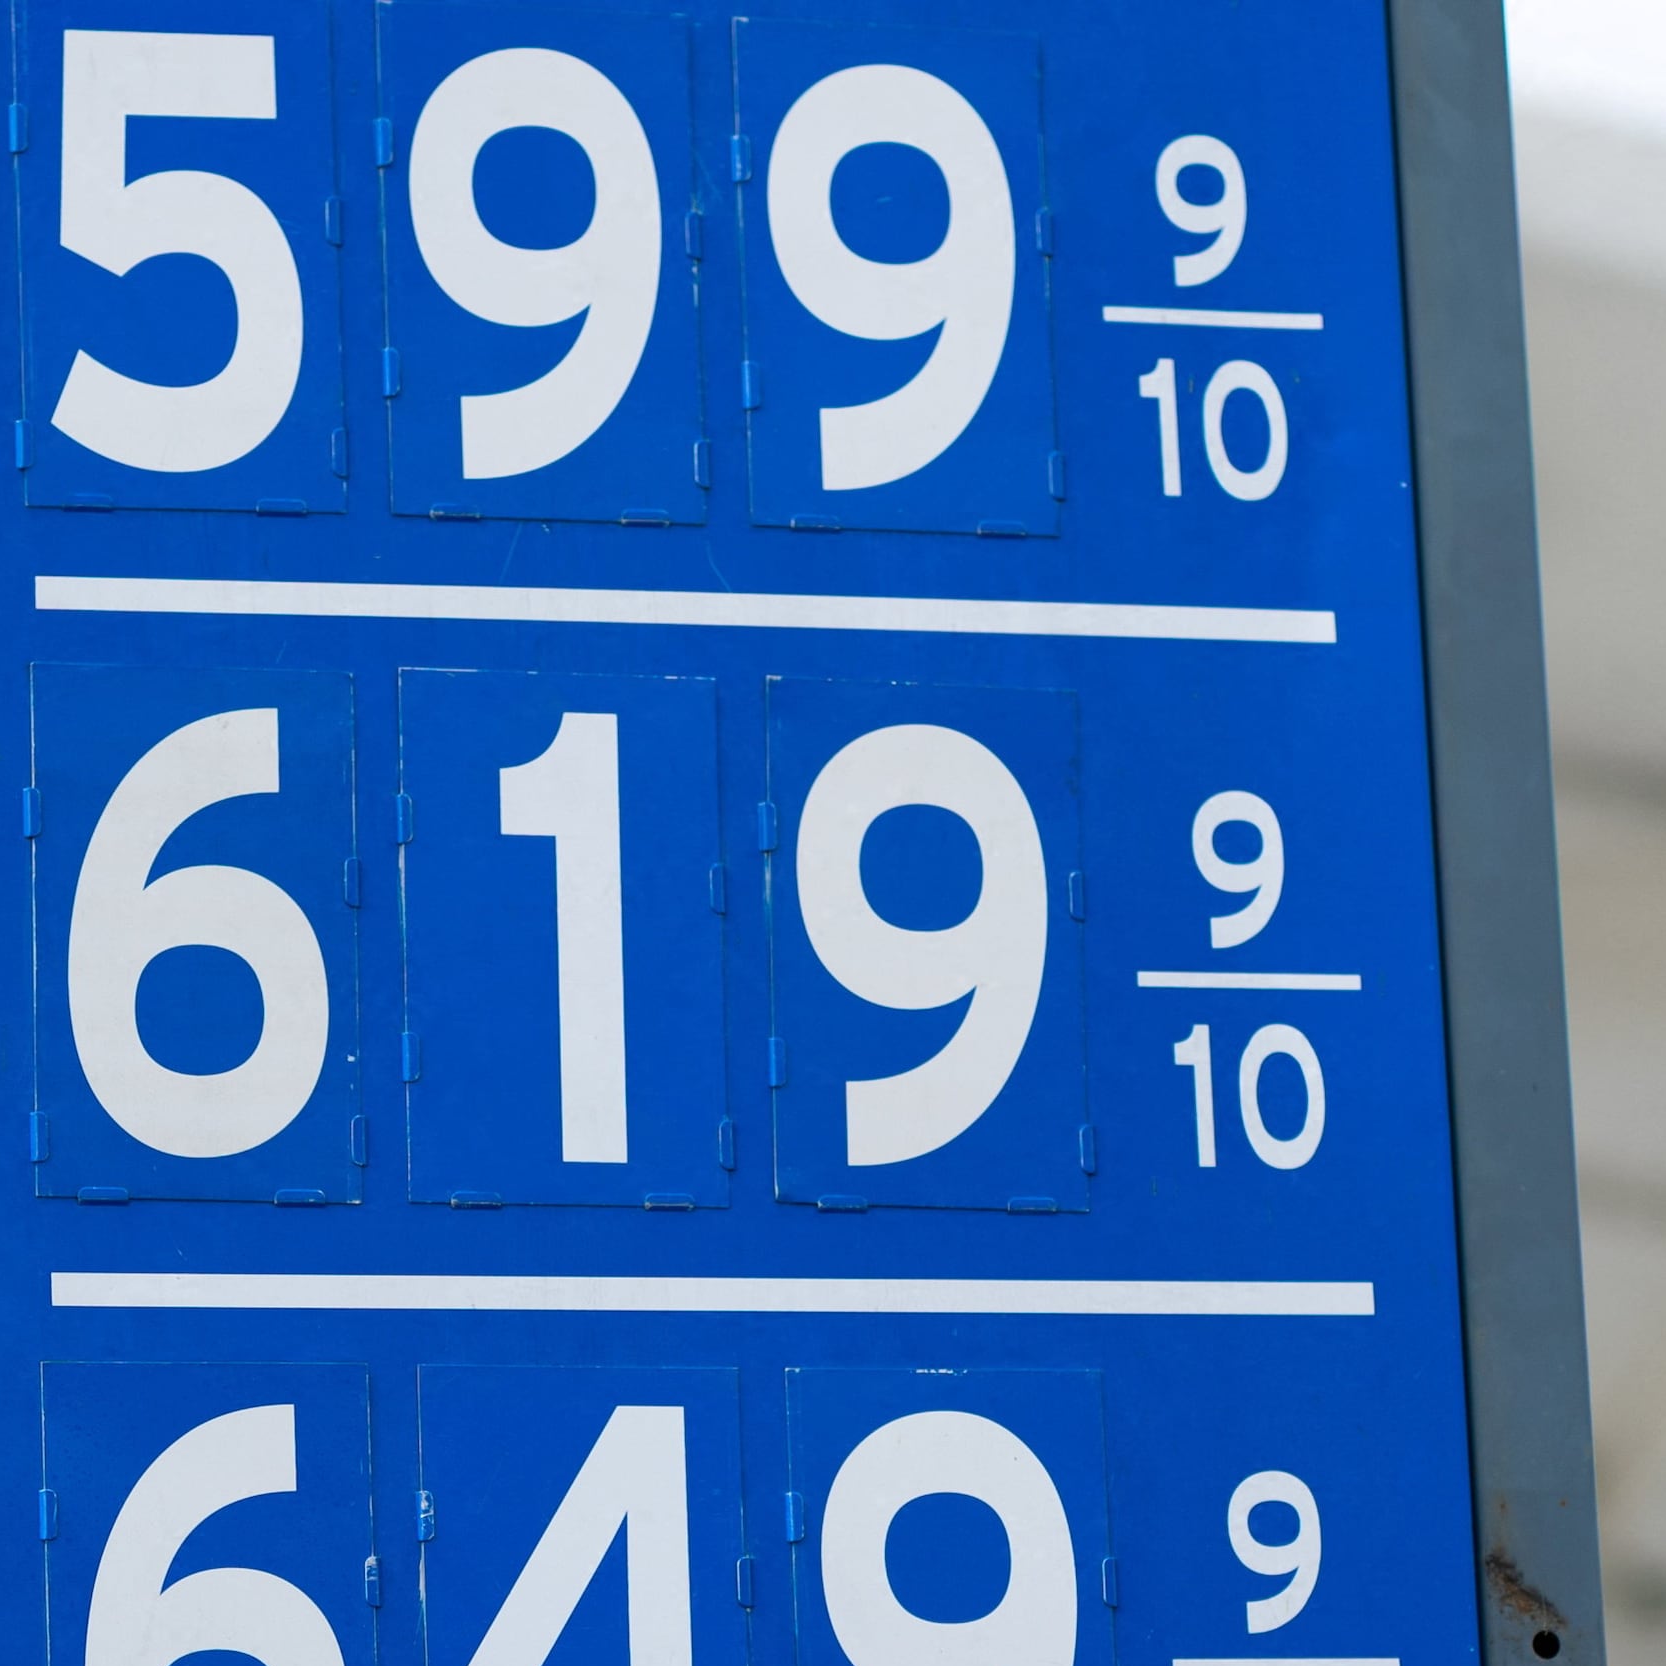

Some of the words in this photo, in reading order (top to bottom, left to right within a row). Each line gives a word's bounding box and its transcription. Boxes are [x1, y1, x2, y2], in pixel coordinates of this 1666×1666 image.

[50, 28, 1016, 491] 599
[1155, 134, 1247, 287] 9
[1139, 357, 1289, 501] 10
[67, 707, 1049, 1167] 619
[1191, 790, 1285, 949] 9
[1173, 1023, 1326, 1170] 10
[1227, 1469, 1323, 1634] 9
